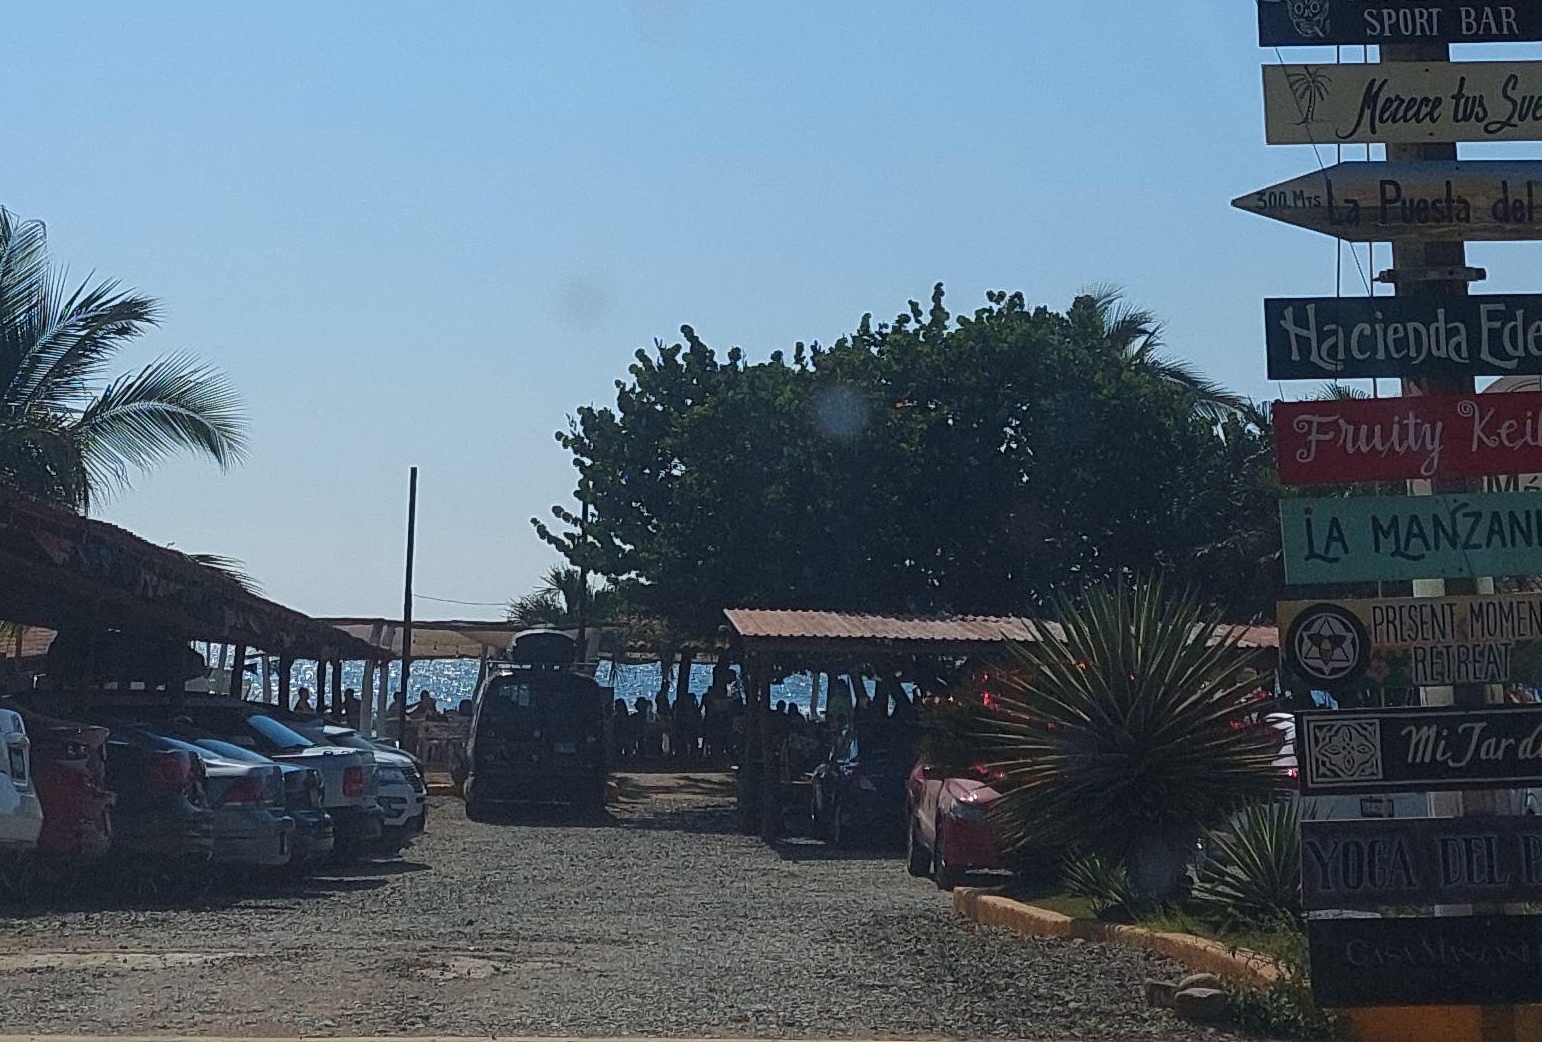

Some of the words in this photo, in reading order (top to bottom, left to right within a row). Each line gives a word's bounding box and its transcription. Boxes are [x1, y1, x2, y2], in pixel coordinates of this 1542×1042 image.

[1364, 7, 1443, 37] SPORT
[1460, 7, 1519, 36] BAR
[1335, 78, 1443, 141] Merece
[1452, 77, 1489, 124] tus
[1325, 180, 1361, 226] La
[1380, 179, 1472, 226] Puesta
[1492, 180, 1533, 223] del
[1280, 303, 1469, 373] Hacienda
[1291, 411, 1447, 479] Fruity
[1304, 510, 1351, 564] LA
[1371, 603, 1458, 645] PRESENT
[1411, 641, 1514, 687] RETREAT
[1400, 724, 1449, 764] Mi
[1304, 836, 1418, 893] YOGA
[1438, 834, 1512, 888] DEL
